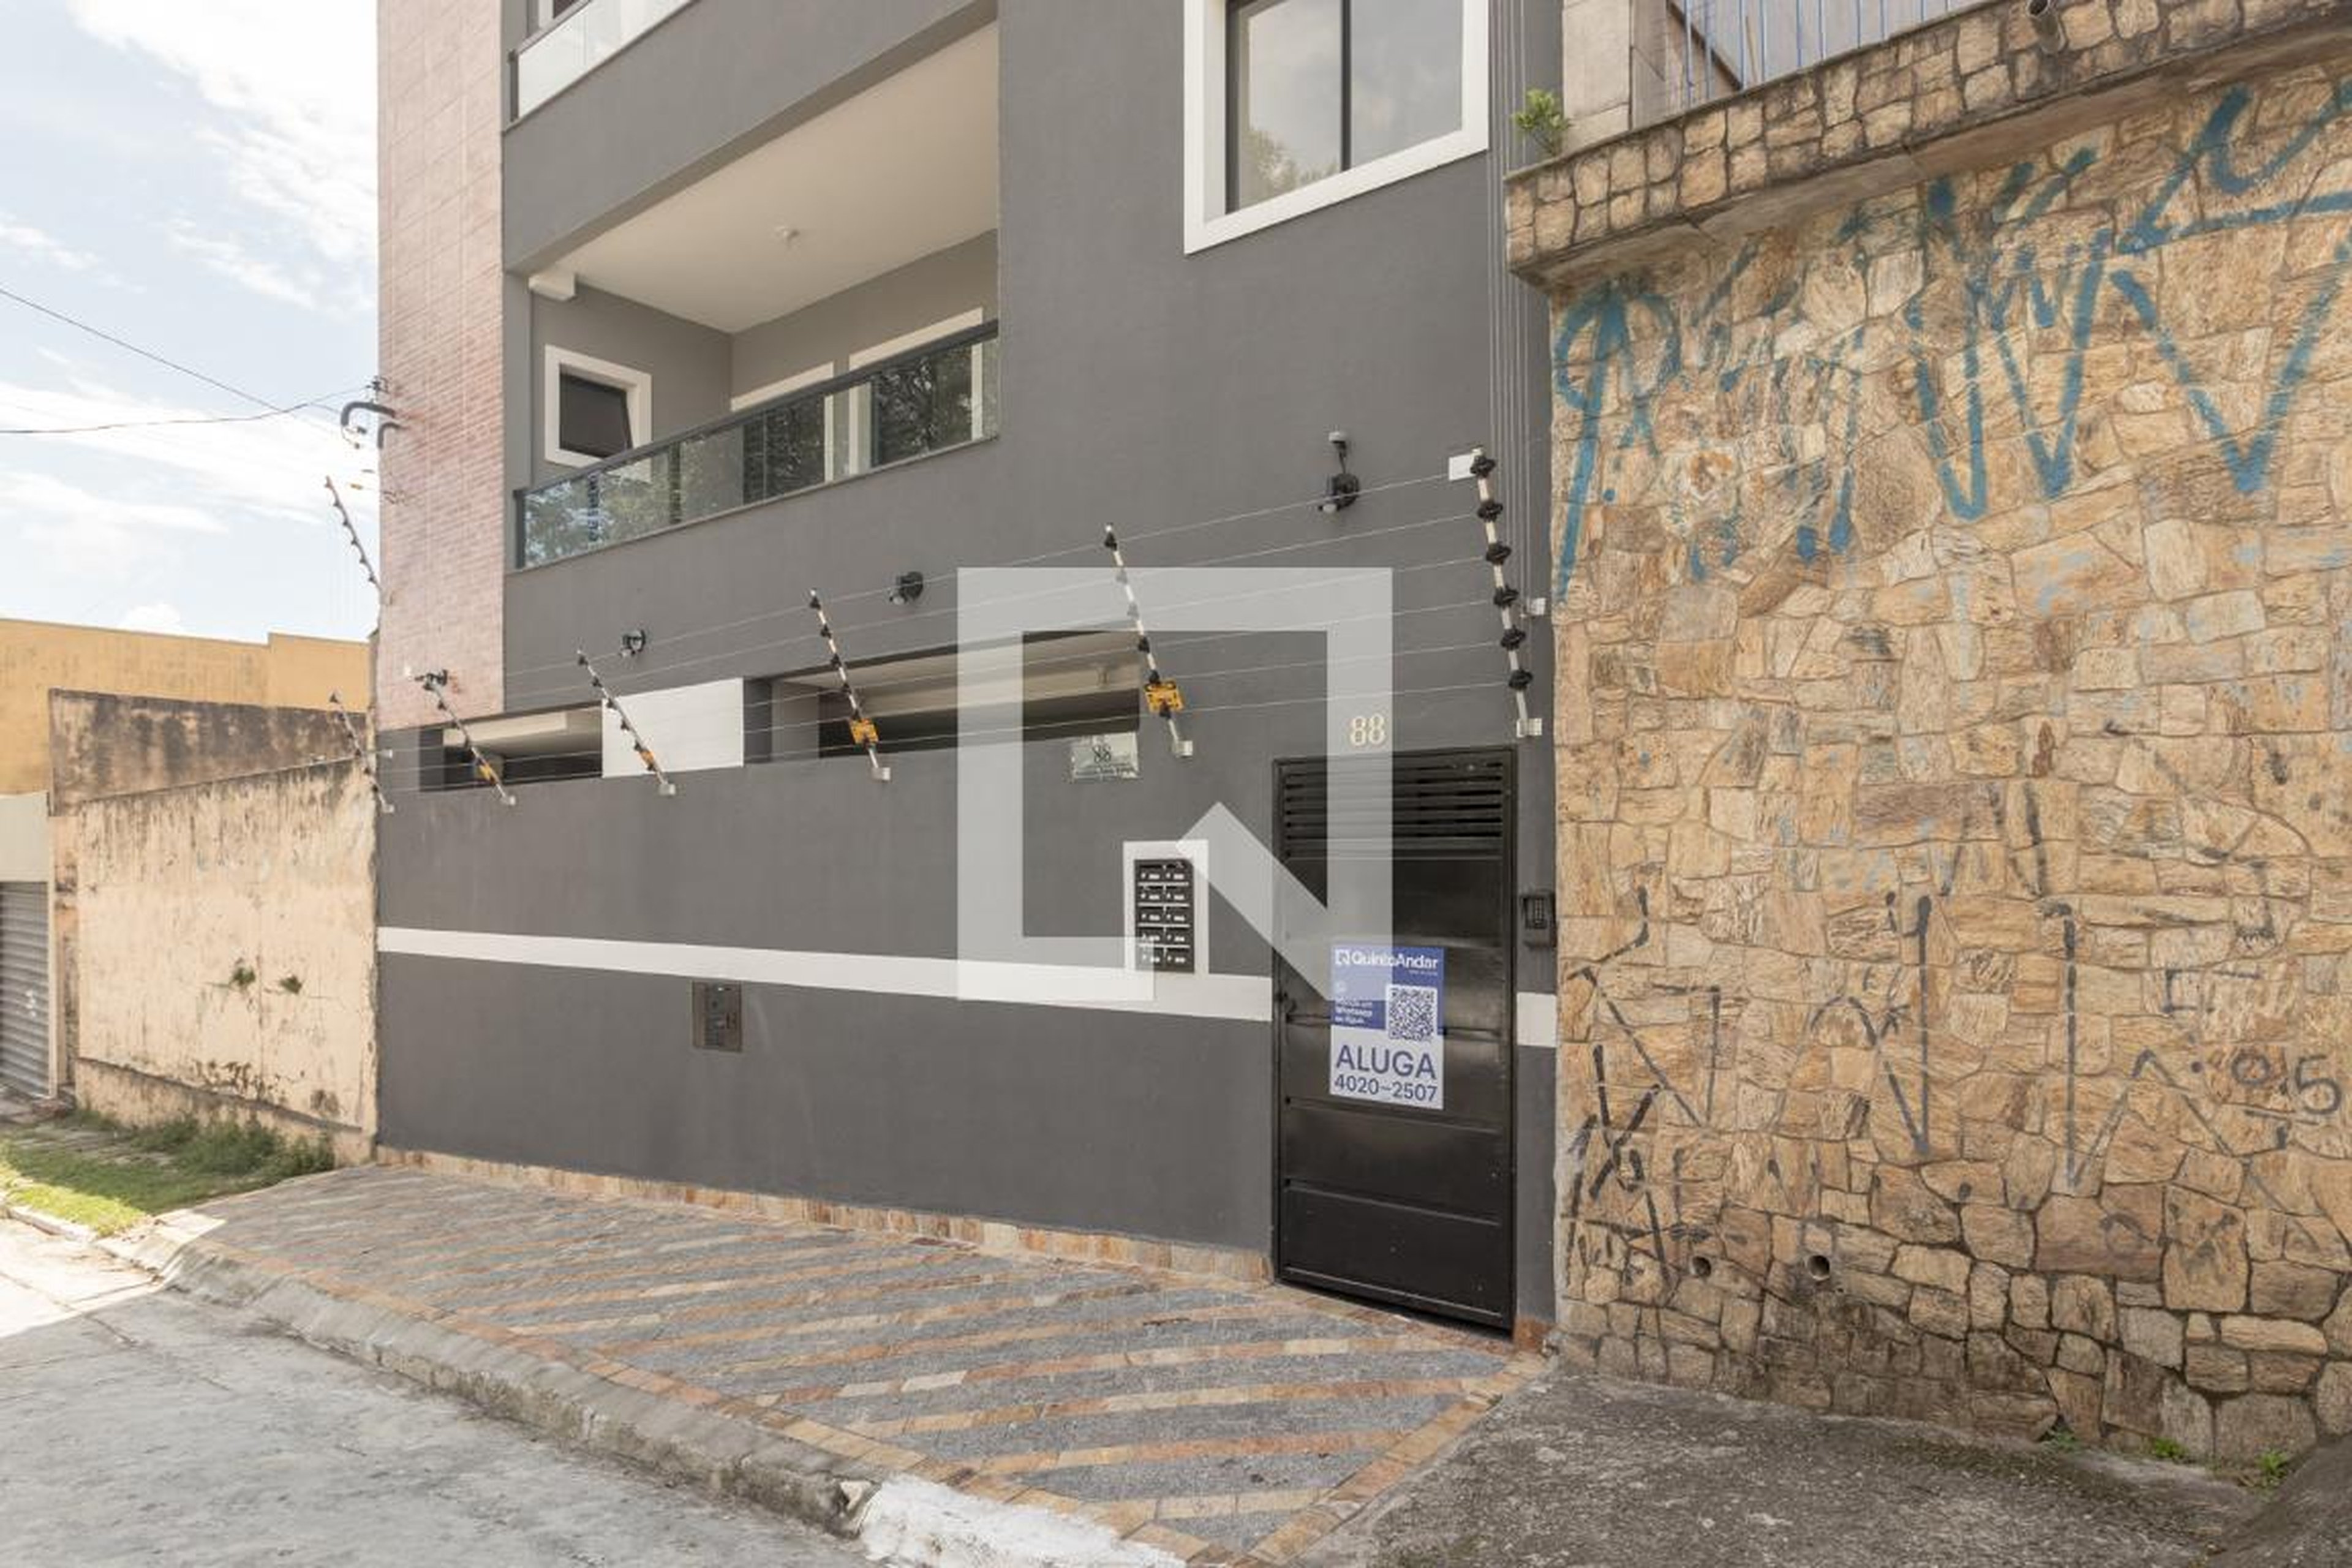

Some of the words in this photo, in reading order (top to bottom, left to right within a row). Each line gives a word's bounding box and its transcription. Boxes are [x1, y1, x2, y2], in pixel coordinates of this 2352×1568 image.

[1350, 714, 1385, 746] 88
[1351, 951, 1438, 969] QuintoAndar
[1336, 1044, 1436, 1079] ALUGA
[1335, 1074, 1438, 1101] 4020-2507
